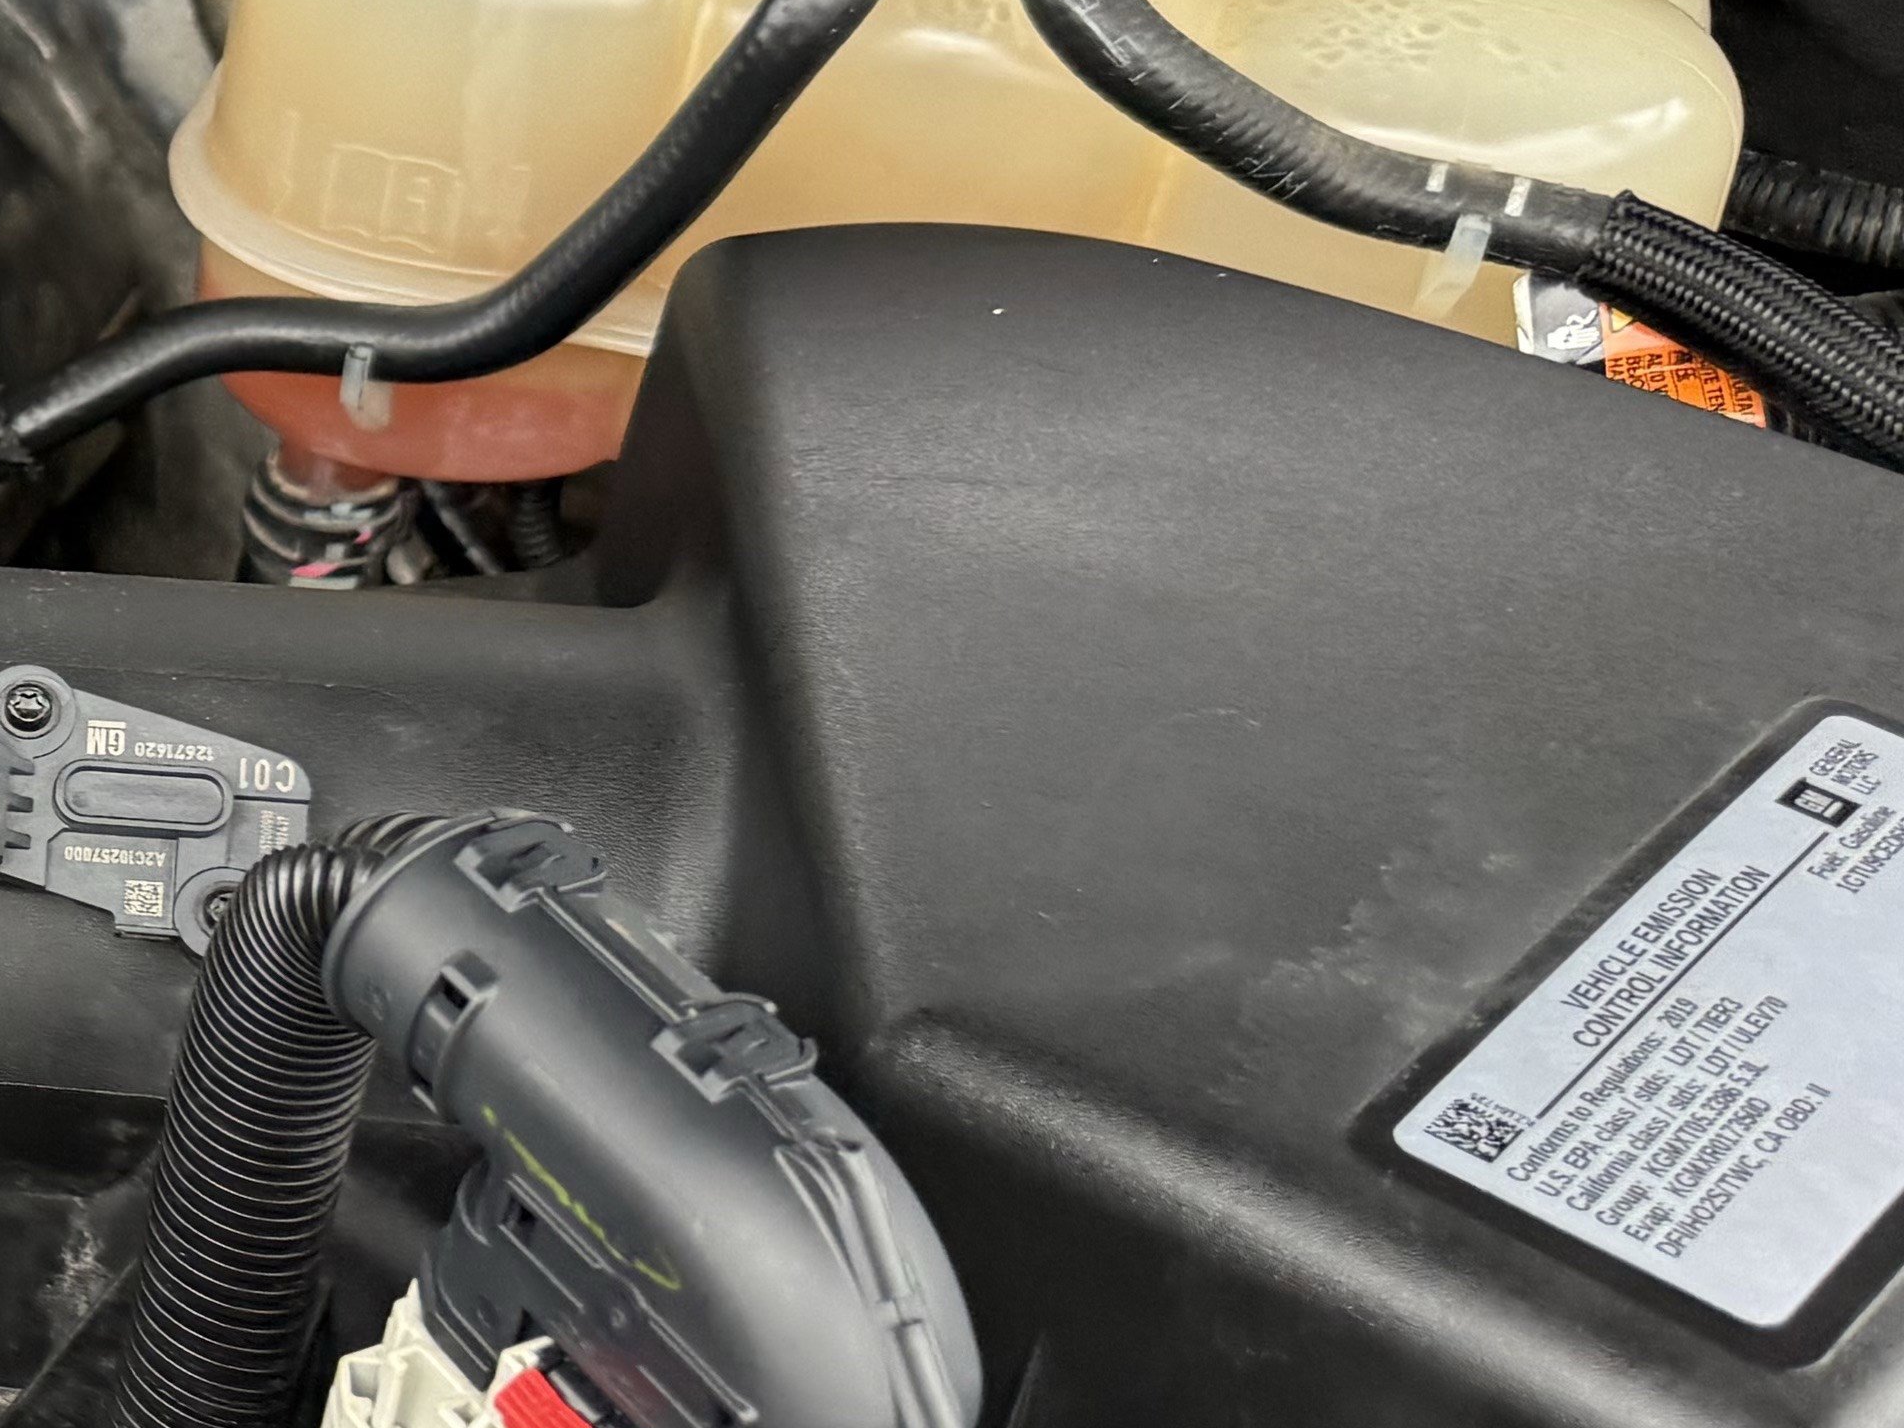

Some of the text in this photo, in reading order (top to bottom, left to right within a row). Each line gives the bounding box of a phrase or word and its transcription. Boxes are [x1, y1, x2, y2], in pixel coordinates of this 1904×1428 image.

[86, 725, 215, 762] 12671620 GM
[1849, 774, 1883, 796] LLC
[1838, 806, 1897, 850] Gasoline
[1559, 868, 1722, 1010] VEHICLE EMISSION
[1572, 865, 1771, 1048] CONTROL INFORMATION
[1506, 997, 1699, 1182] Conforms to Regulations: 2019
[1533, 1169, 1579, 1198] U.S.
[1561, 1140, 1605, 1171] EPA
[1593, 1107, 1638, 1142] class
[1633, 1069, 1676, 1103] stds:
[1661, 1035, 1702, 1068] LDT
[1692, 996, 1744, 1035] TIER3
[1565, 1150, 1640, 1212] California
[1627, 1116, 1672, 1151] class
[1667, 1078, 1708, 1112] stds:
[1696, 1045, 1737, 1078] LDT
[1727, 995, 1789, 1045] ULEV70
[1594, 1180, 1654, 1226] Group:
[1727, 1060, 1770, 1088] 5.3L
[1753, 1130, 1791, 1154] CA
[1774, 1095, 1823, 1131] OBD:
[1622, 1201, 1676, 1243] Evap:
